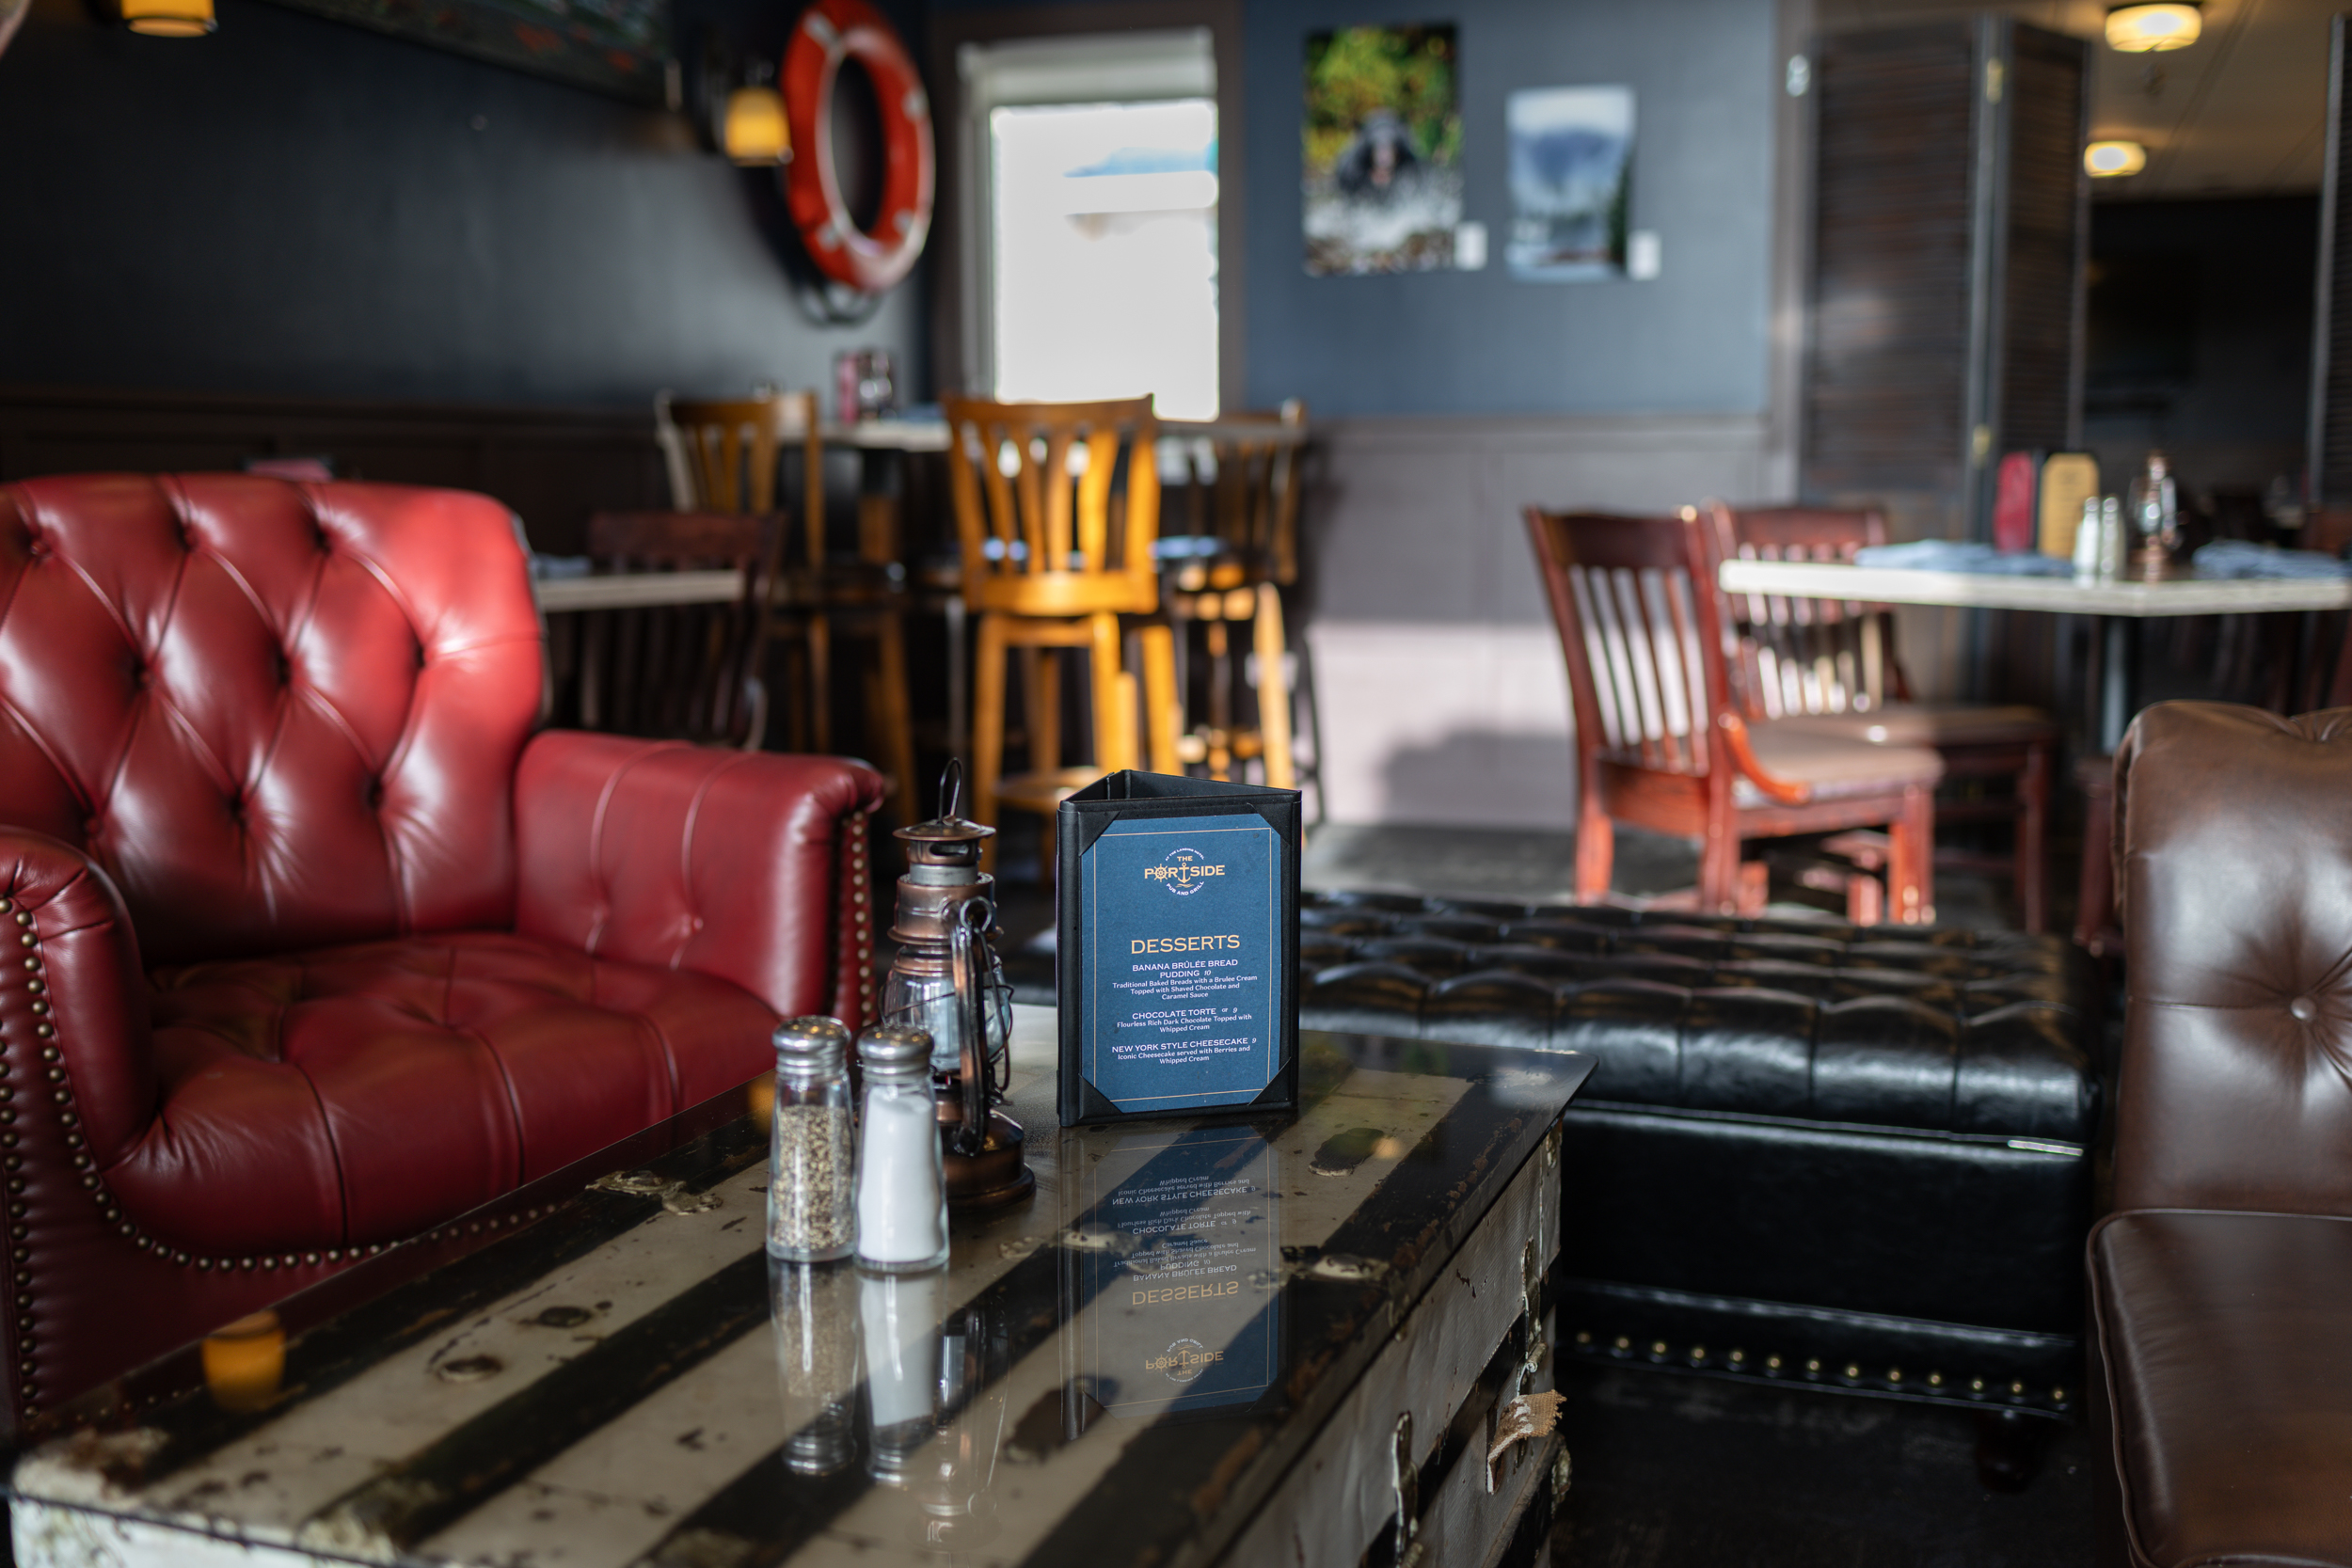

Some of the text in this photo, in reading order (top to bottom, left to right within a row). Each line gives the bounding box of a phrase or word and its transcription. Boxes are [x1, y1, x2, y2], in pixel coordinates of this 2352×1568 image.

[1167, 883, 1176, 894] PUB
[1190, 881, 1204, 894] GRILL
[1131, 935, 1240, 954] DESSERTS
[1132, 959, 1238, 972] BANANA BRÛLÉE BREAD
[1160, 970, 1200, 978] PUDDING
[1132, 1010, 1186, 1020] CHOCOLATE
[1190, 1037, 1248, 1048] CHEESECAKE
